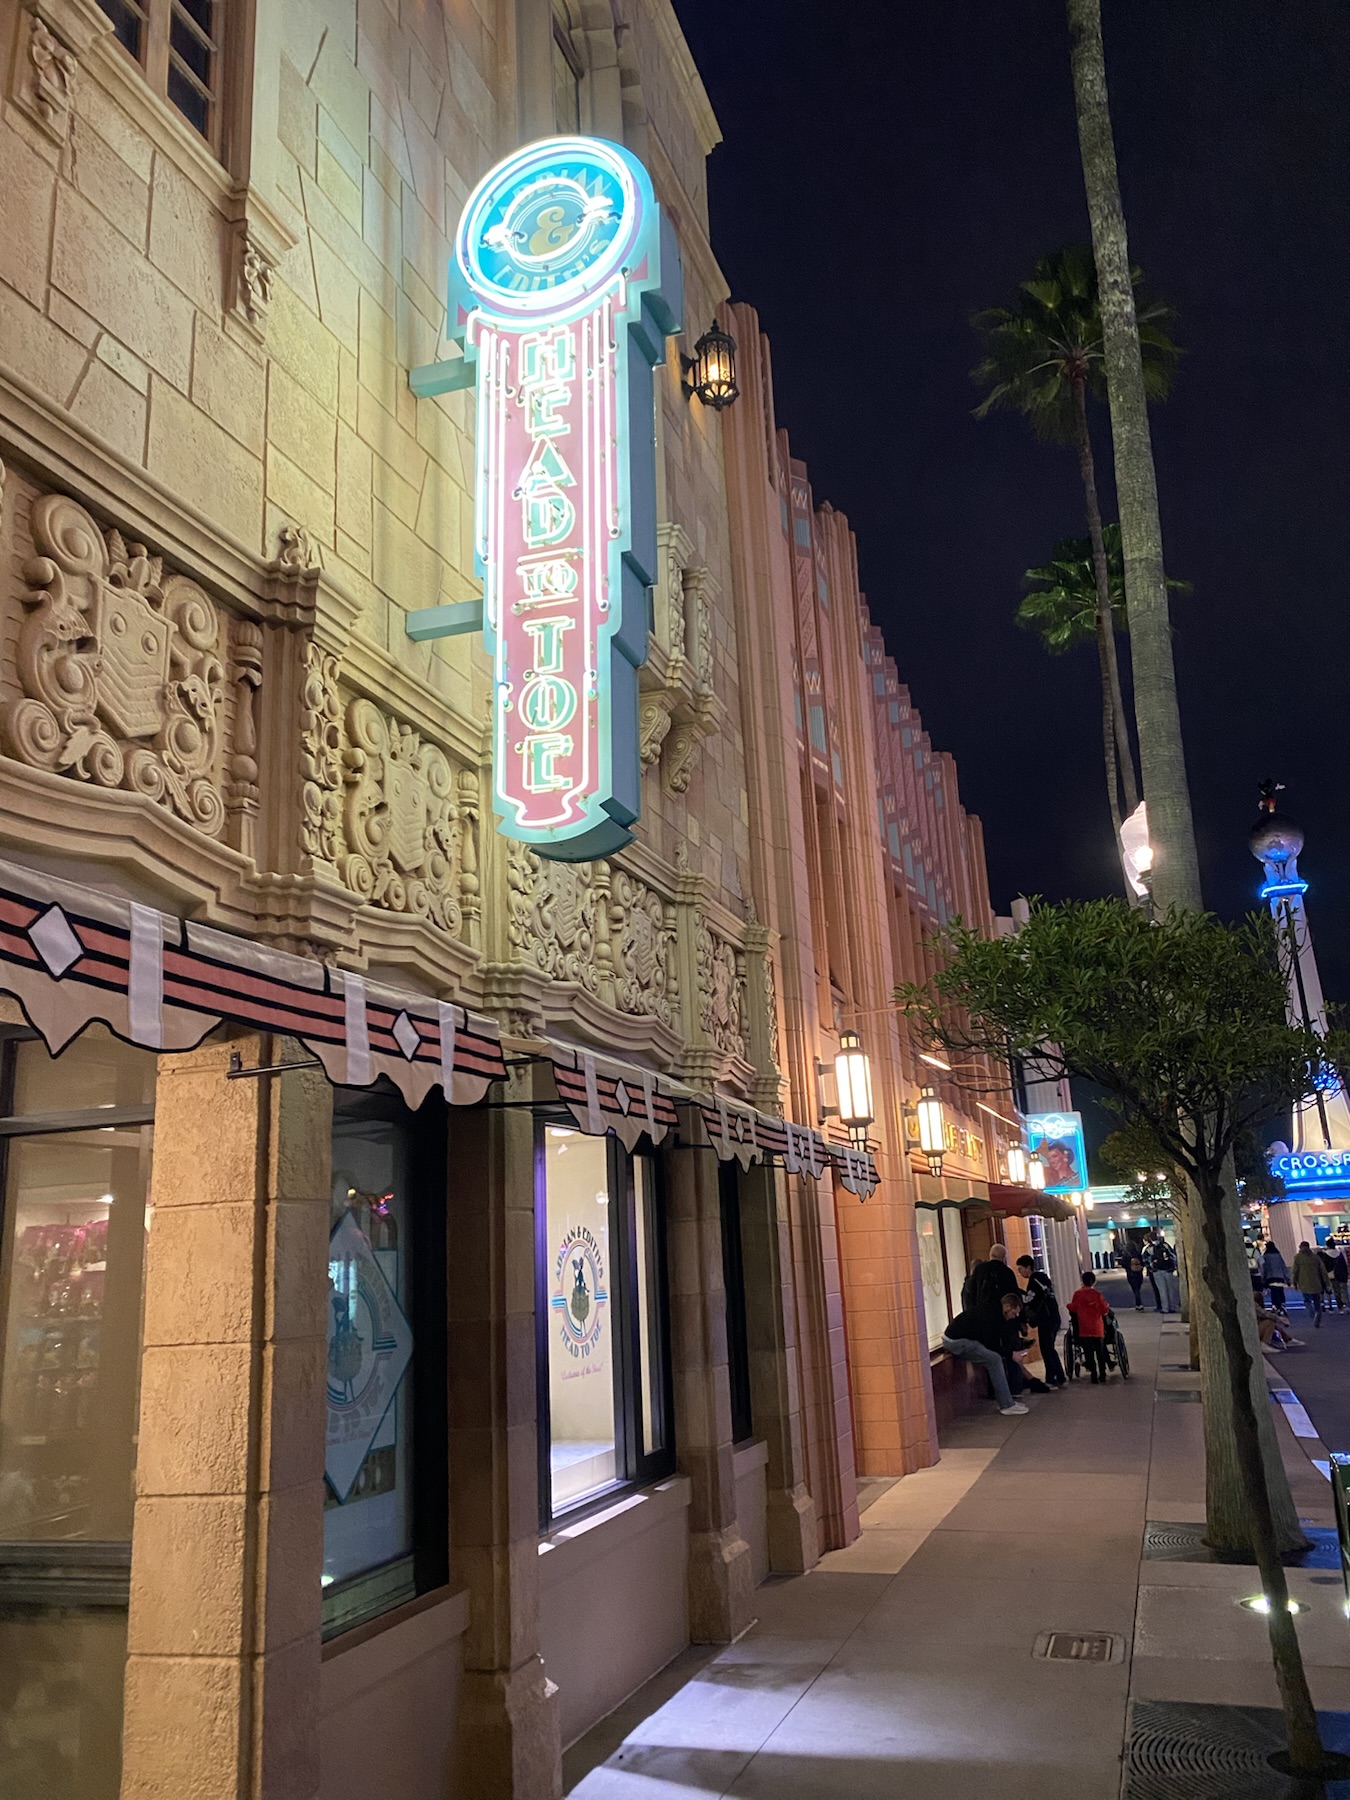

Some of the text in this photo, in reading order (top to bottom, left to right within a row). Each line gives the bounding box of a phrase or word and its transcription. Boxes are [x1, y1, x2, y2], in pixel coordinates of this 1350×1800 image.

[529, 206, 574, 256] &
[493, 240, 610, 291] EDITH'S
[515, 323, 578, 794] HEAD TO TOE
[560, 1319, 603, 1359] HEAD TO TOE
